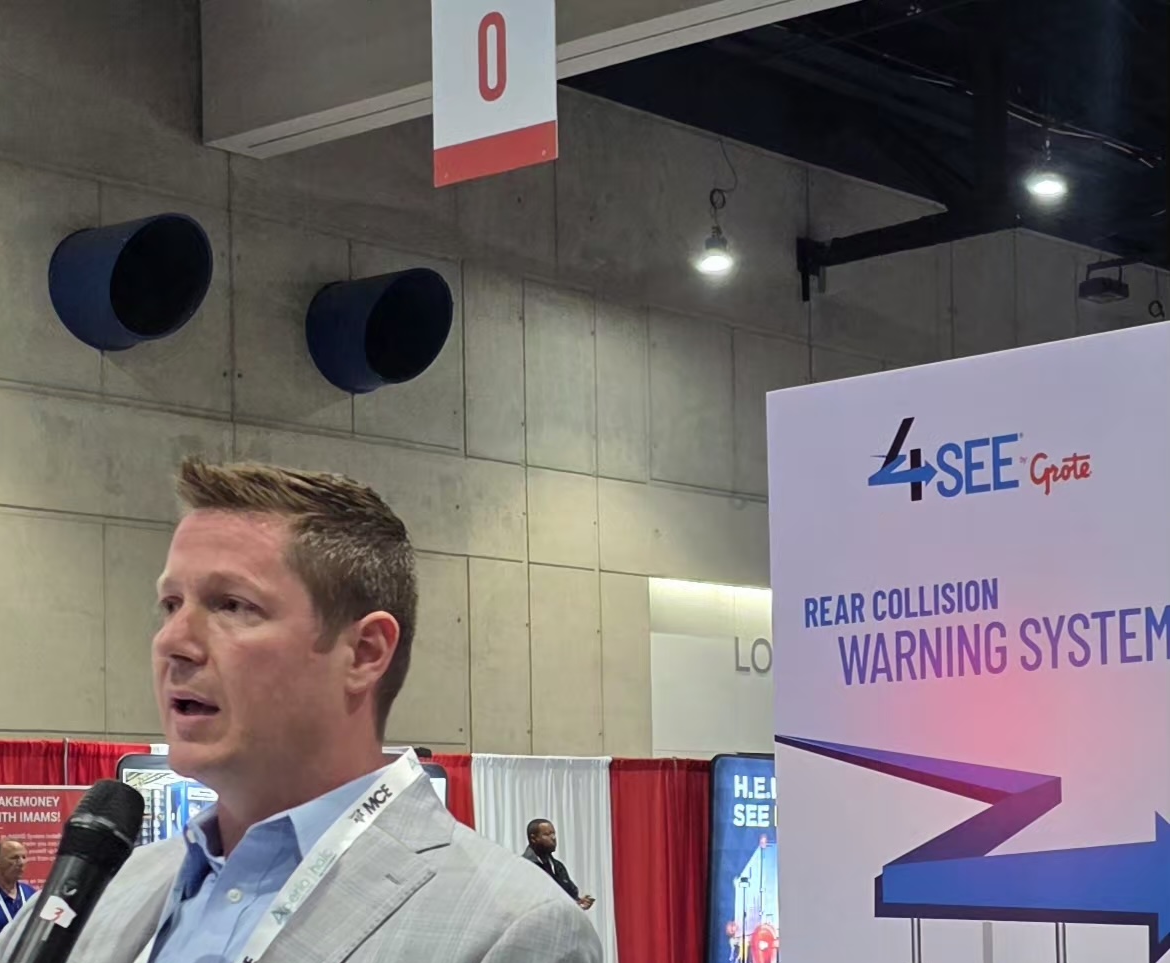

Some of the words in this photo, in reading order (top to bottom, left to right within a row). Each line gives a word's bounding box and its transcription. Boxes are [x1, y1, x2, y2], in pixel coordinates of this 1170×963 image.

[1030, 452, 1092, 495] Grote
[805, 592, 865, 628] REAR
[872, 577, 999, 622] COLLISION
[838, 621, 1007, 686] WARNING
[1019, 603, 1170, 672] SYSTEM
[20, 811, 61, 823] IMAMS!
[362, 784, 393, 815] MCE
[733, 803, 770, 827] SEE
